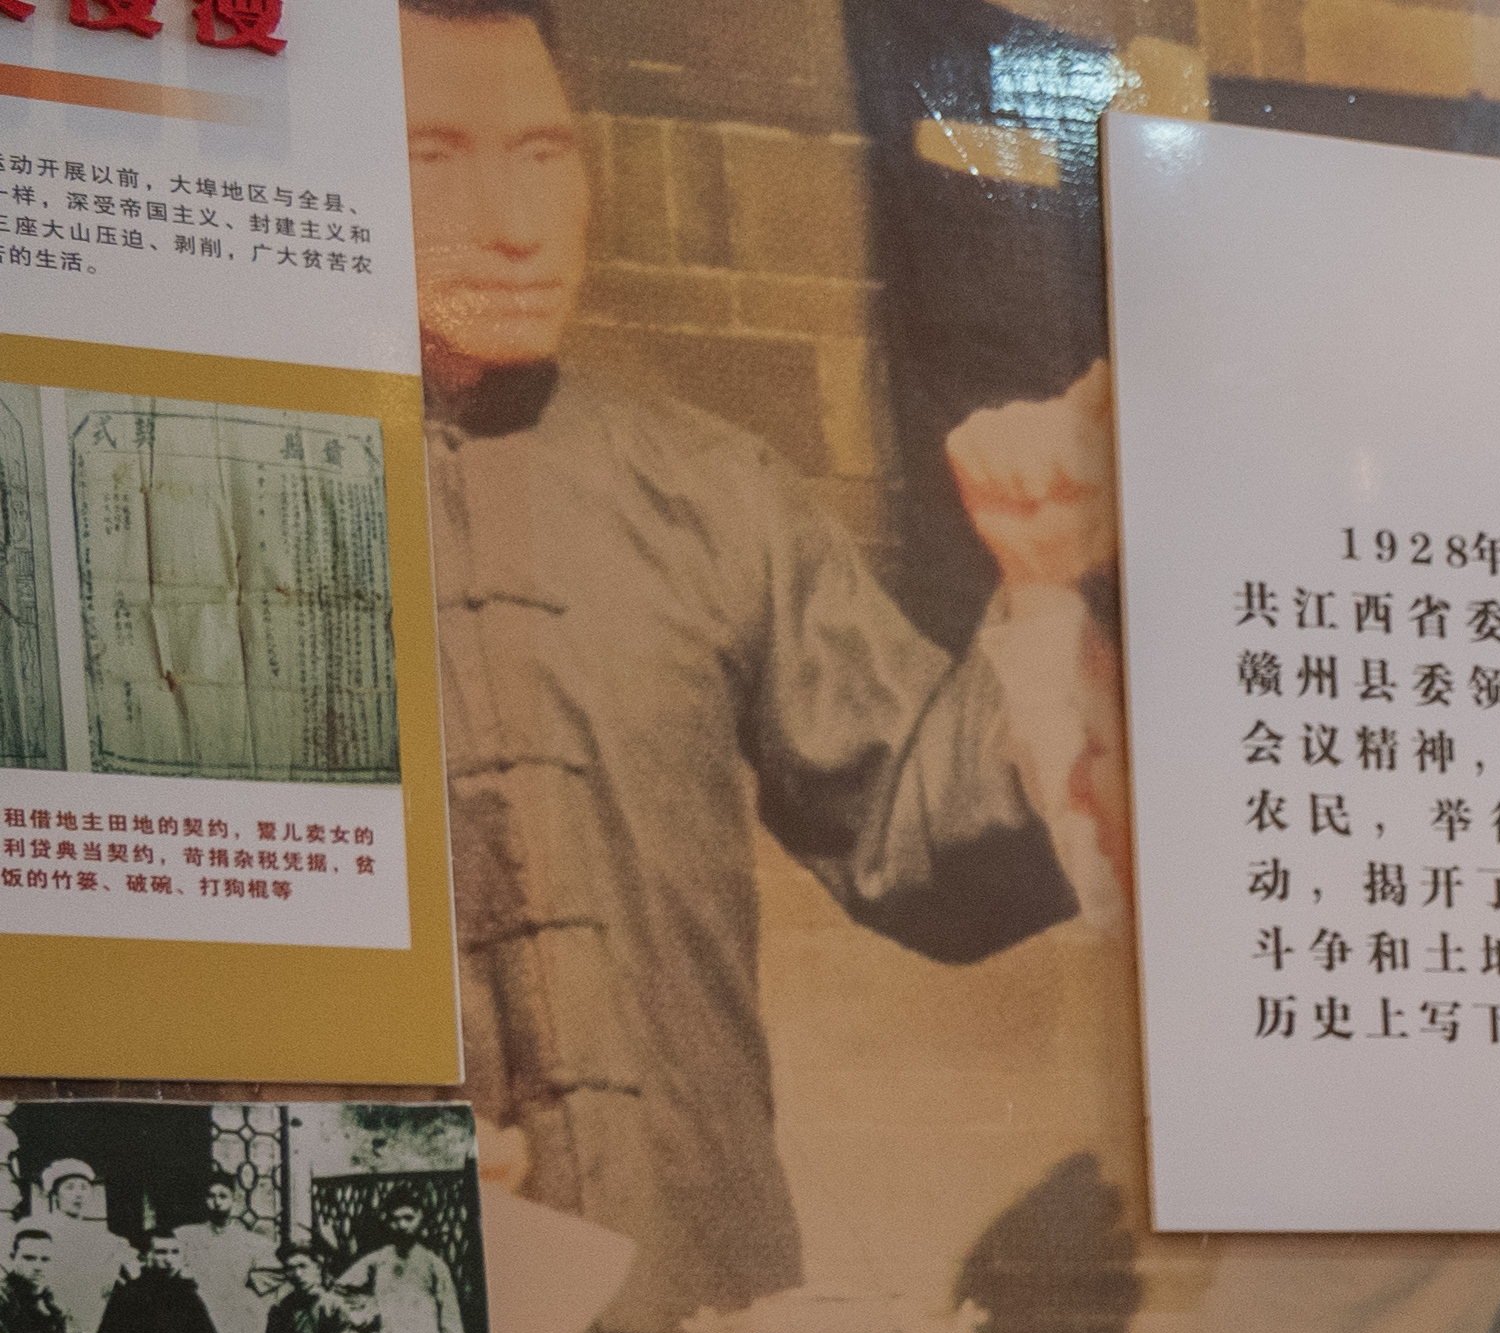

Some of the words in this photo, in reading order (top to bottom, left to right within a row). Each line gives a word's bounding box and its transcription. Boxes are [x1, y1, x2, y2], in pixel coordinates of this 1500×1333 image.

[0, 153, 359, 215] 动开展以前，大埠地区与全县、
[0, 245, 98, 275] 的生活。
